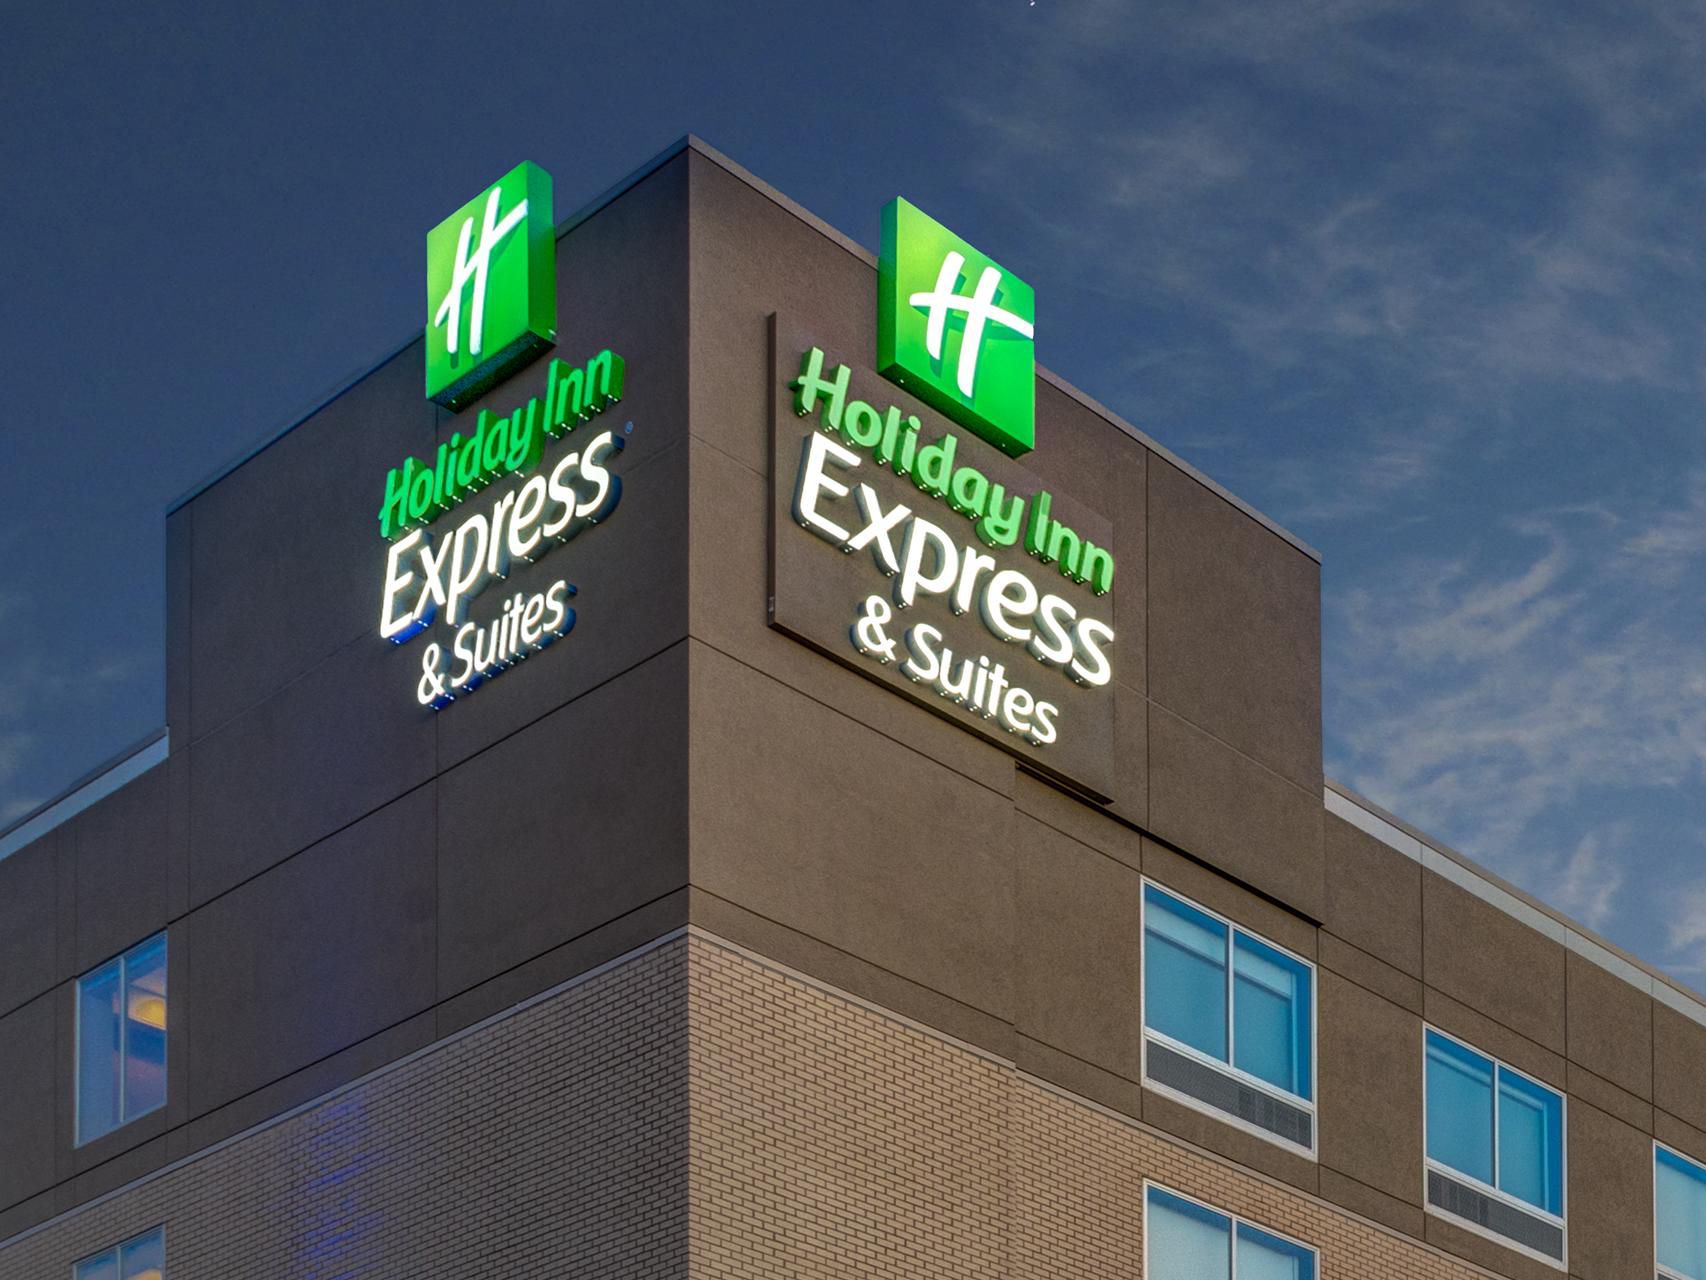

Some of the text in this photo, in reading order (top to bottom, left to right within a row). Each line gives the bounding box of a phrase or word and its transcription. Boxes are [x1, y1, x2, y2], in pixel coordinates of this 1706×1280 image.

[379, 350, 618, 539] Holiday Inn
[380, 431, 613, 639] Express
[795, 346, 1114, 597] Holiday Inn
[417, 579, 567, 705] & Suites
[799, 430, 1115, 687] Express
[856, 595, 1060, 745] & Suites
